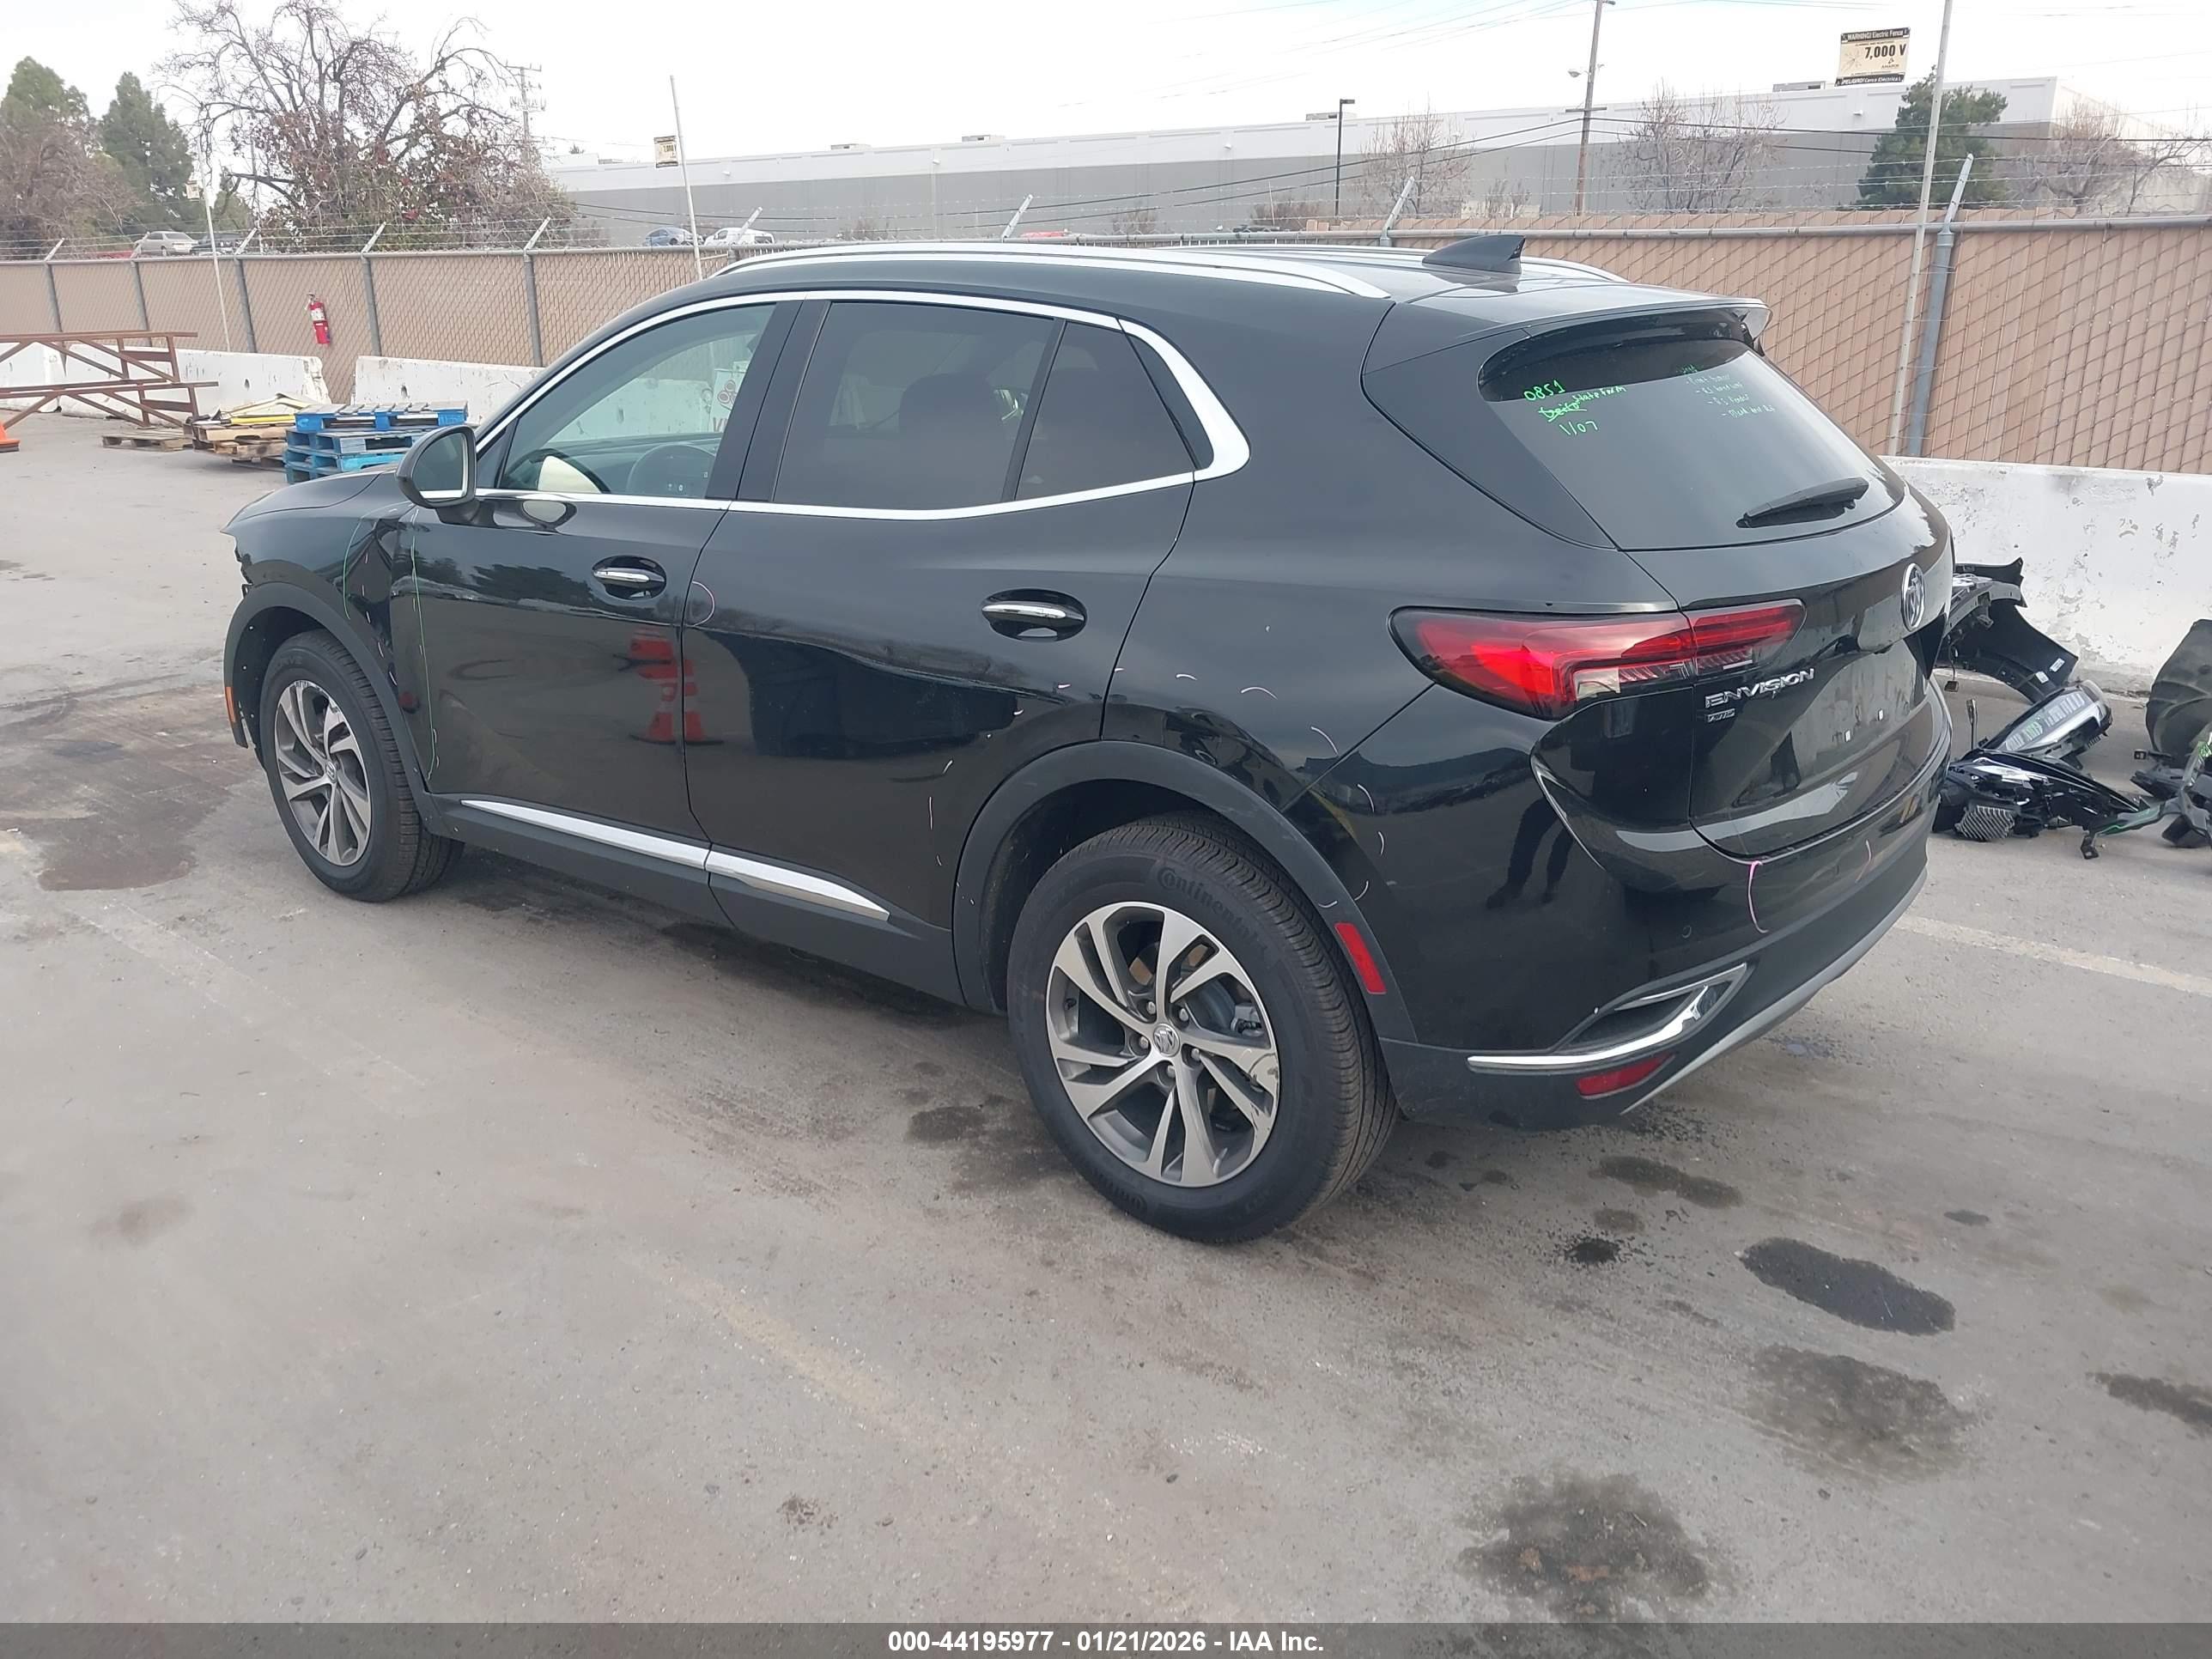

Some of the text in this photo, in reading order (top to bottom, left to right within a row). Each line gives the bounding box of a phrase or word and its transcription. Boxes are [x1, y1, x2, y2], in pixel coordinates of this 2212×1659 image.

[1865, 44, 1906, 59] 7,000 V
[1523, 380, 1565, 401] 0851
[1705, 668, 1814, 708] ENVISION
